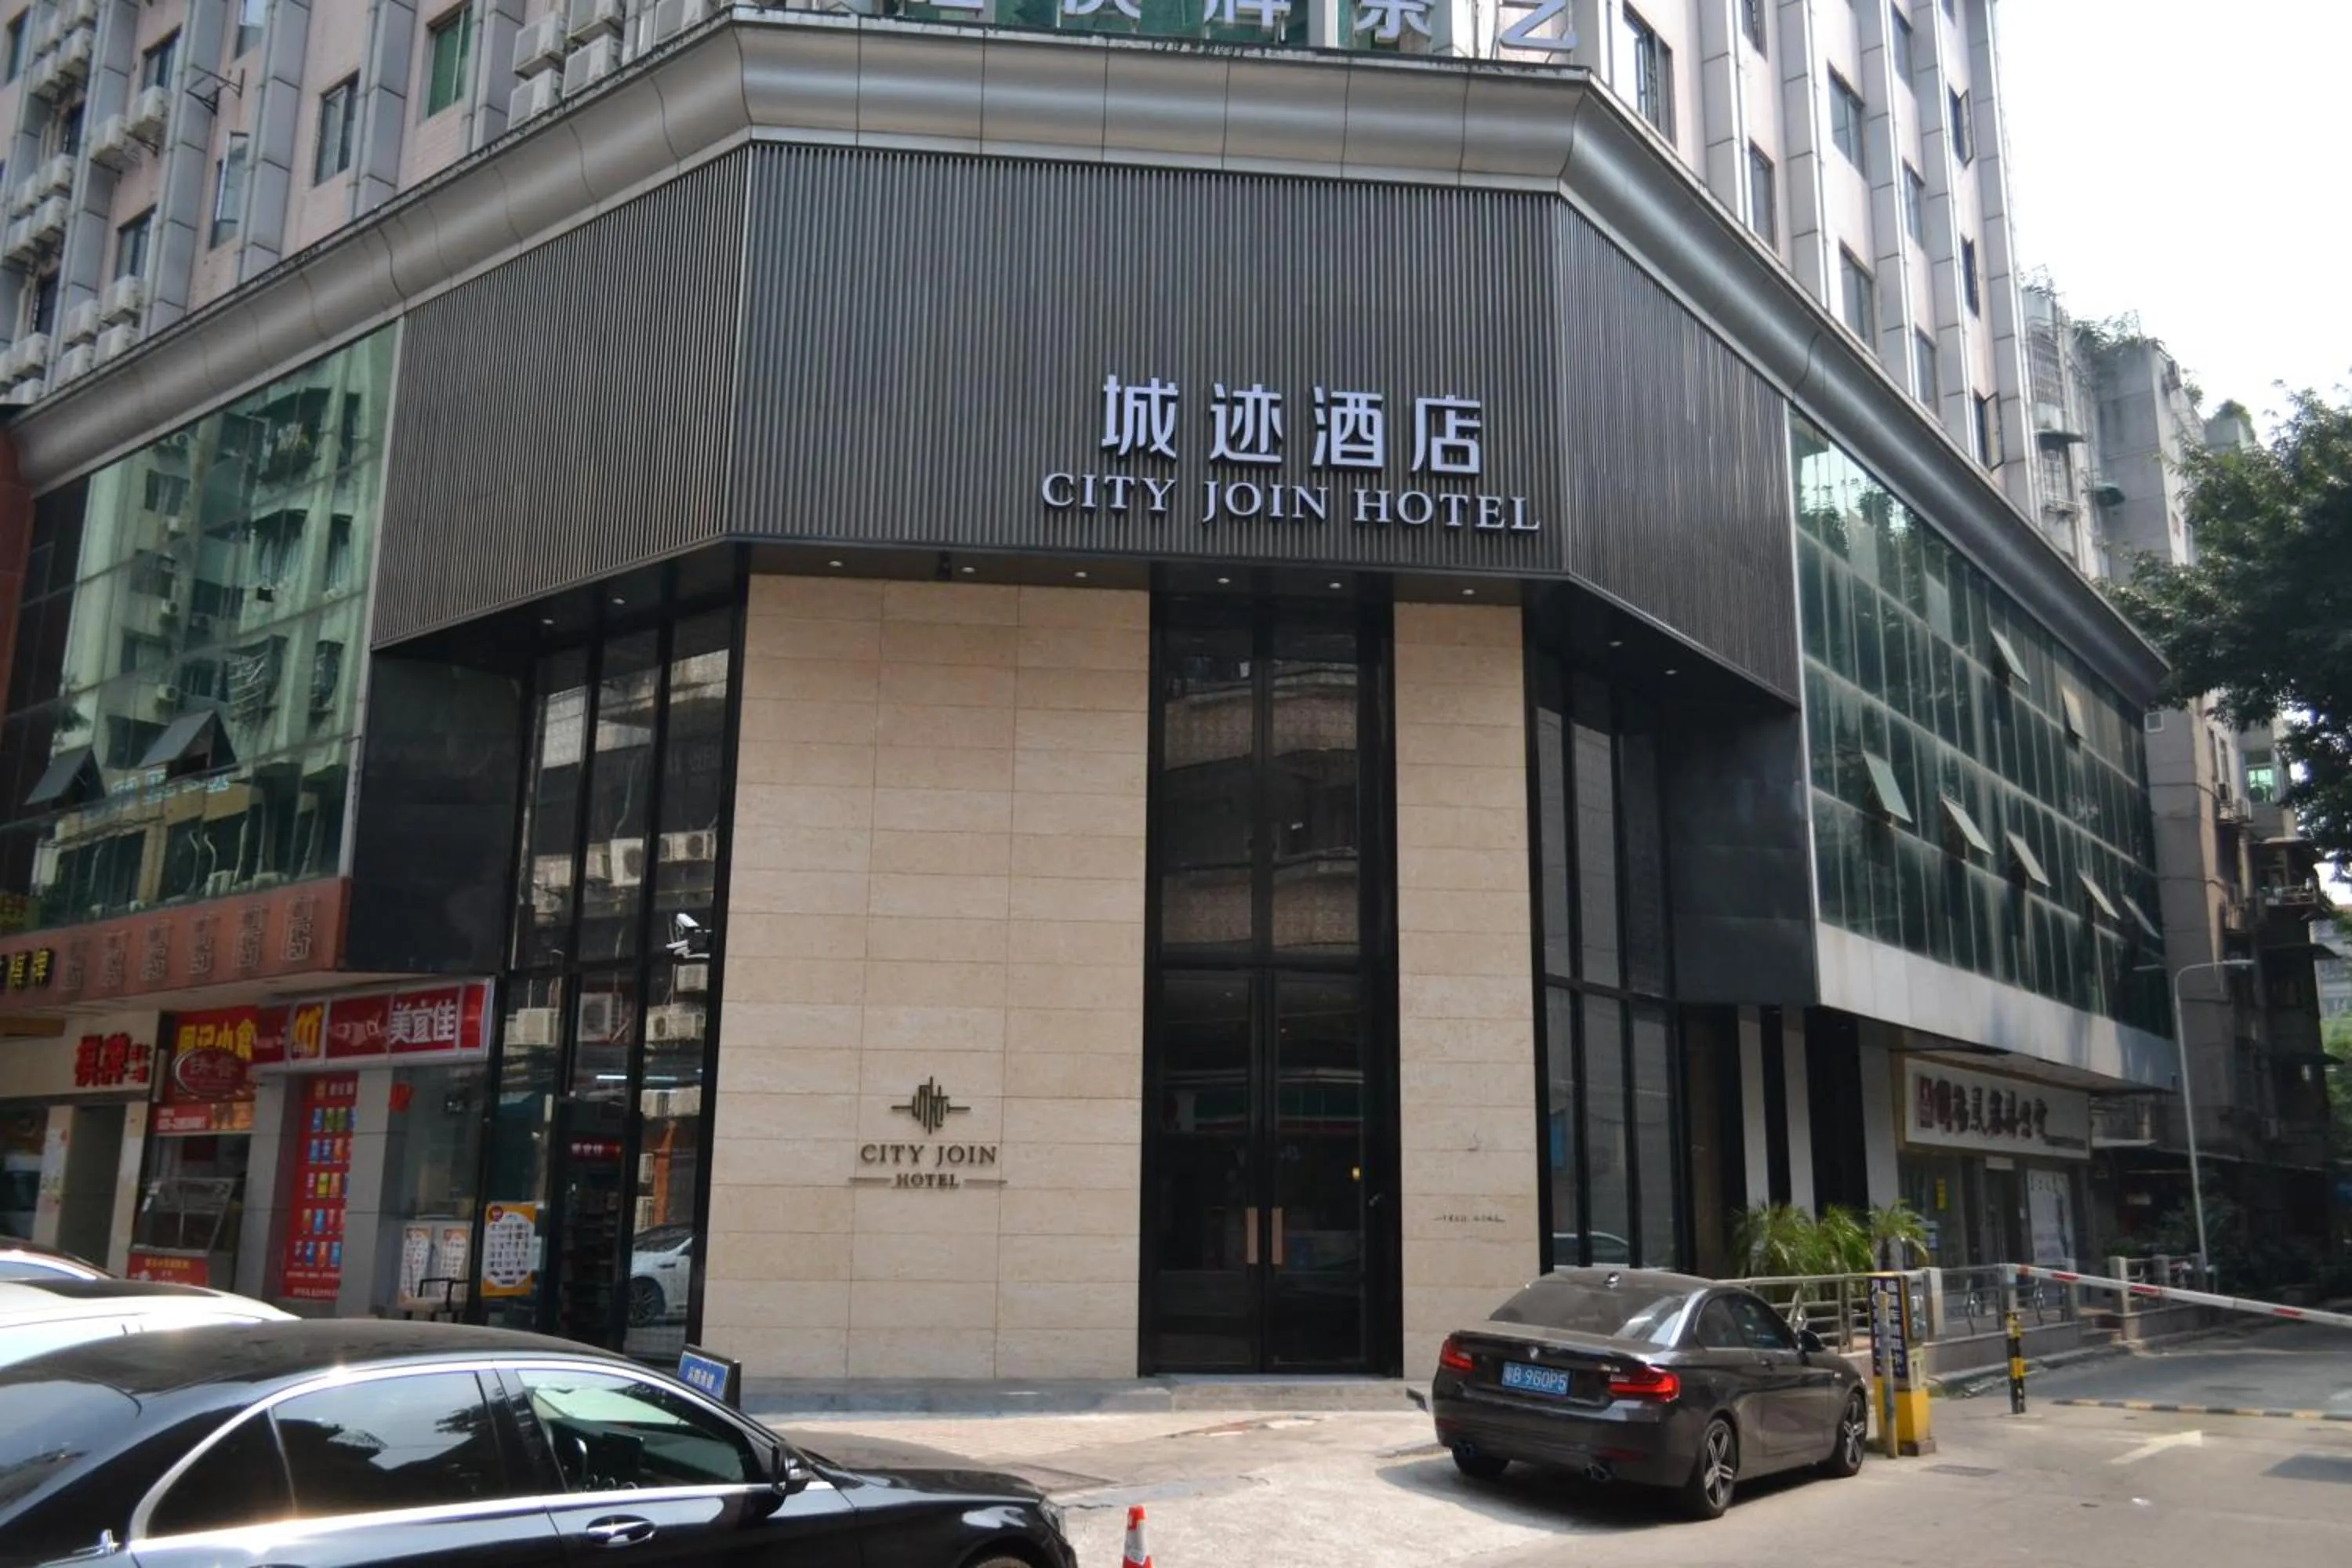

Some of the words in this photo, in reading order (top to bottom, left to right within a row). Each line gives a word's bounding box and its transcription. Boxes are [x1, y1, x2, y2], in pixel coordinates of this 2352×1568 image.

[1100, 374, 1483, 475] 城迹酒店
[1041, 472, 1176, 514] CITY
[1202, 480, 1330, 524] JOIN
[1353, 489, 1541, 532] HOTEL
[391, 998, 457, 1045] 美宜佳
[860, 1144, 924, 1164] CITY
[936, 1145, 997, 1167] JOIN
[895, 1173, 960, 1189] HOTEL
